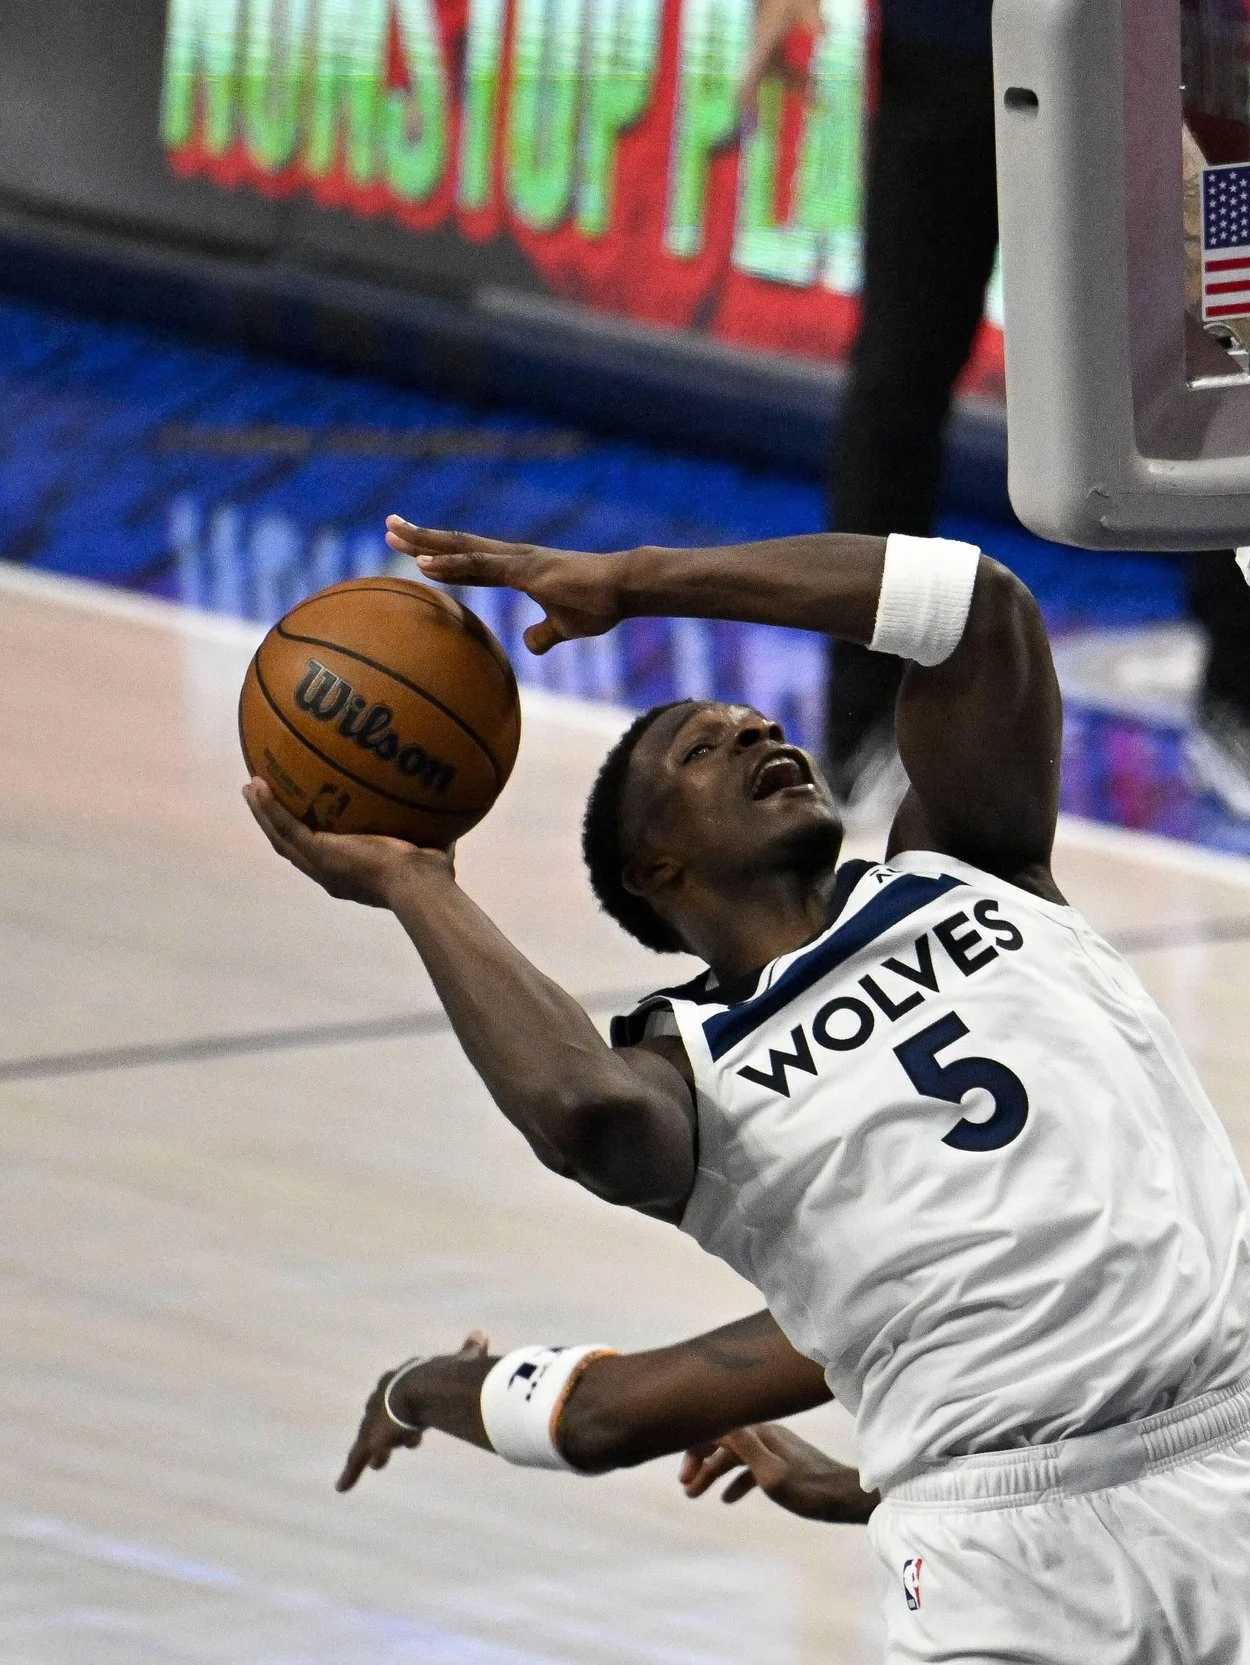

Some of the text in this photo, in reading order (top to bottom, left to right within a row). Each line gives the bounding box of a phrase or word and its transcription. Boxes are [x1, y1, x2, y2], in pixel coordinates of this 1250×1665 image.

[294, 657, 456, 792] Wilson
[736, 899, 1024, 1098] WOLVES
[893, 1011, 1029, 1152] 5
